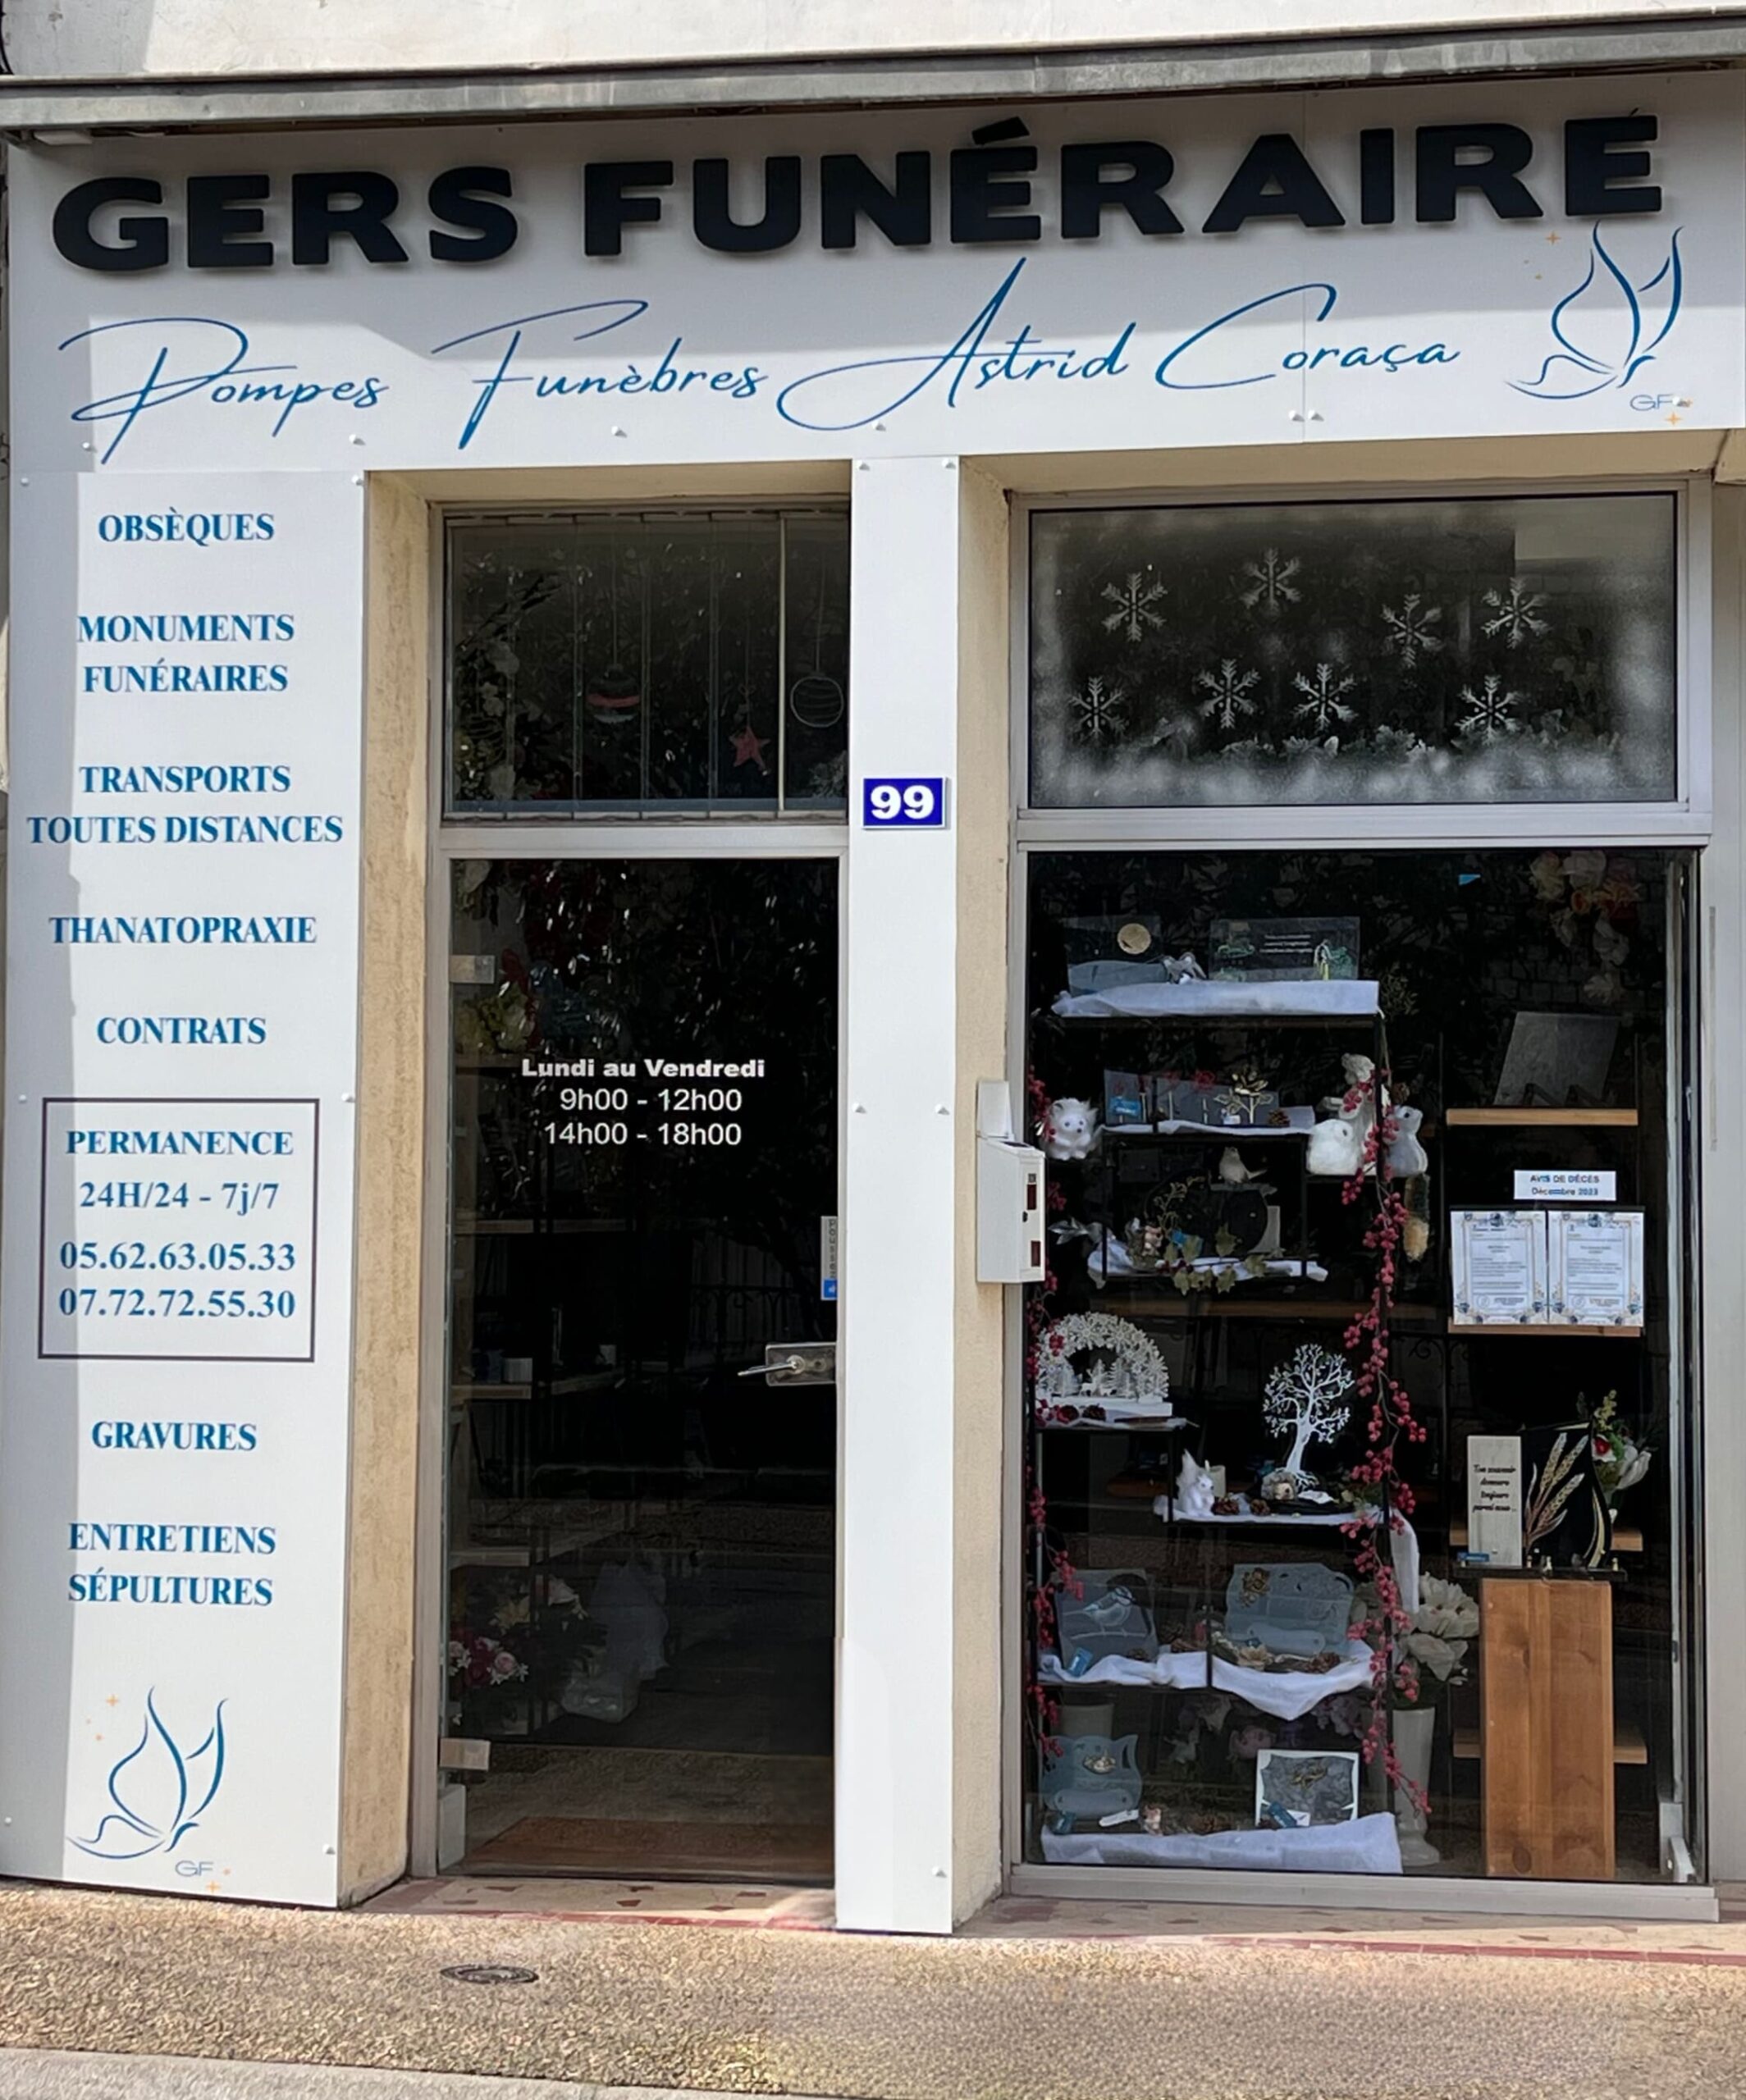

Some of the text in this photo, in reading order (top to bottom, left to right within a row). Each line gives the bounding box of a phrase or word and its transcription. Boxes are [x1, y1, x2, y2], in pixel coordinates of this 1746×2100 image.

[53, 115, 1662, 272] GERS FUNÉRAIRE
[58, 257, 1461, 464] Pompes Funèbres Astrid Coraça
[98, 507, 275, 546] OBSÈQUES
[77, 614, 295, 642] MONUMENTS
[83, 659, 288, 693] FUNÉRAIRES
[80, 765, 291, 792] TRANSPORTS
[871, 785, 935, 819] 99
[27, 815, 344, 844] TOUTES DISTANCES
[49, 915, 318, 944] THANATOPRAXIE
[96, 1016, 267, 1044] CONTRATS
[522, 1058, 766, 1077] Lundi au Vendredi
[560, 1089, 628, 1111] 9h00
[658, 1089, 742, 1112] 12h00
[66, 1130, 294, 1156] PERMANENCE
[545, 1122, 628, 1145] 14h00
[658, 1122, 742, 1145] 18h00
[80, 1181, 190, 1209] 24H/24
[222, 1182, 279, 1215] 7j/7
[60, 1242, 295, 1271] 05.62.63.05.33
[58, 1287, 296, 1317] 07.72.72.55.30
[91, 1422, 258, 1450] GRAVURES
[69, 1522, 276, 1553] ENTRETIENS
[68, 1568, 273, 1605] SÉPULTURES
[175, 1860, 214, 1877] GF
